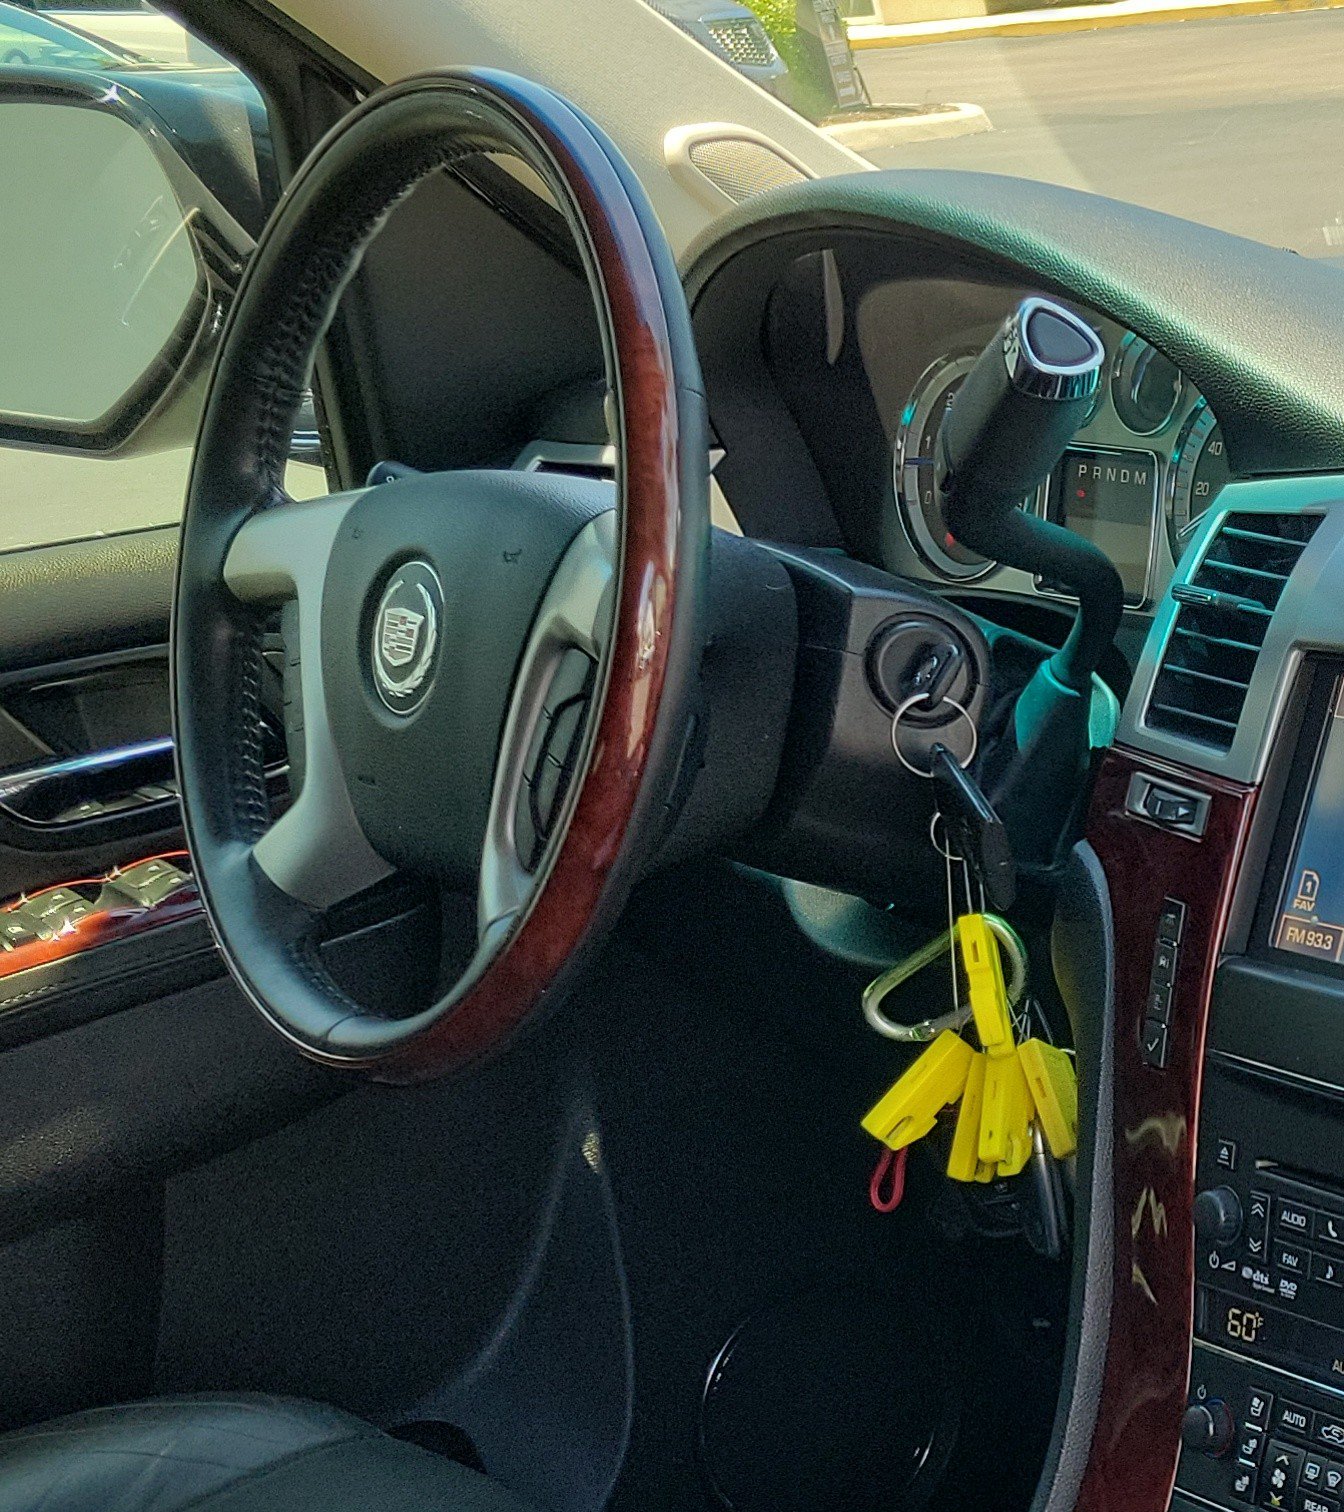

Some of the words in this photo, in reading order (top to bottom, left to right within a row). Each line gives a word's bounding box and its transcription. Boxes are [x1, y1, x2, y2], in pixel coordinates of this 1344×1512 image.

[924, 435, 932, 450] 1
[1207, 441, 1223, 456] 40
[1195, 481, 1210, 496] 20
[1293, 898, 1316, 912] FAV
[1286, 926, 1306, 944] FM
[1305, 931, 1334, 951] 93.3
[1281, 1210, 1306, 1227] AUDIO
[1282, 1252, 1299, 1267] FAV
[1282, 1409, 1307, 1428] AUTO
